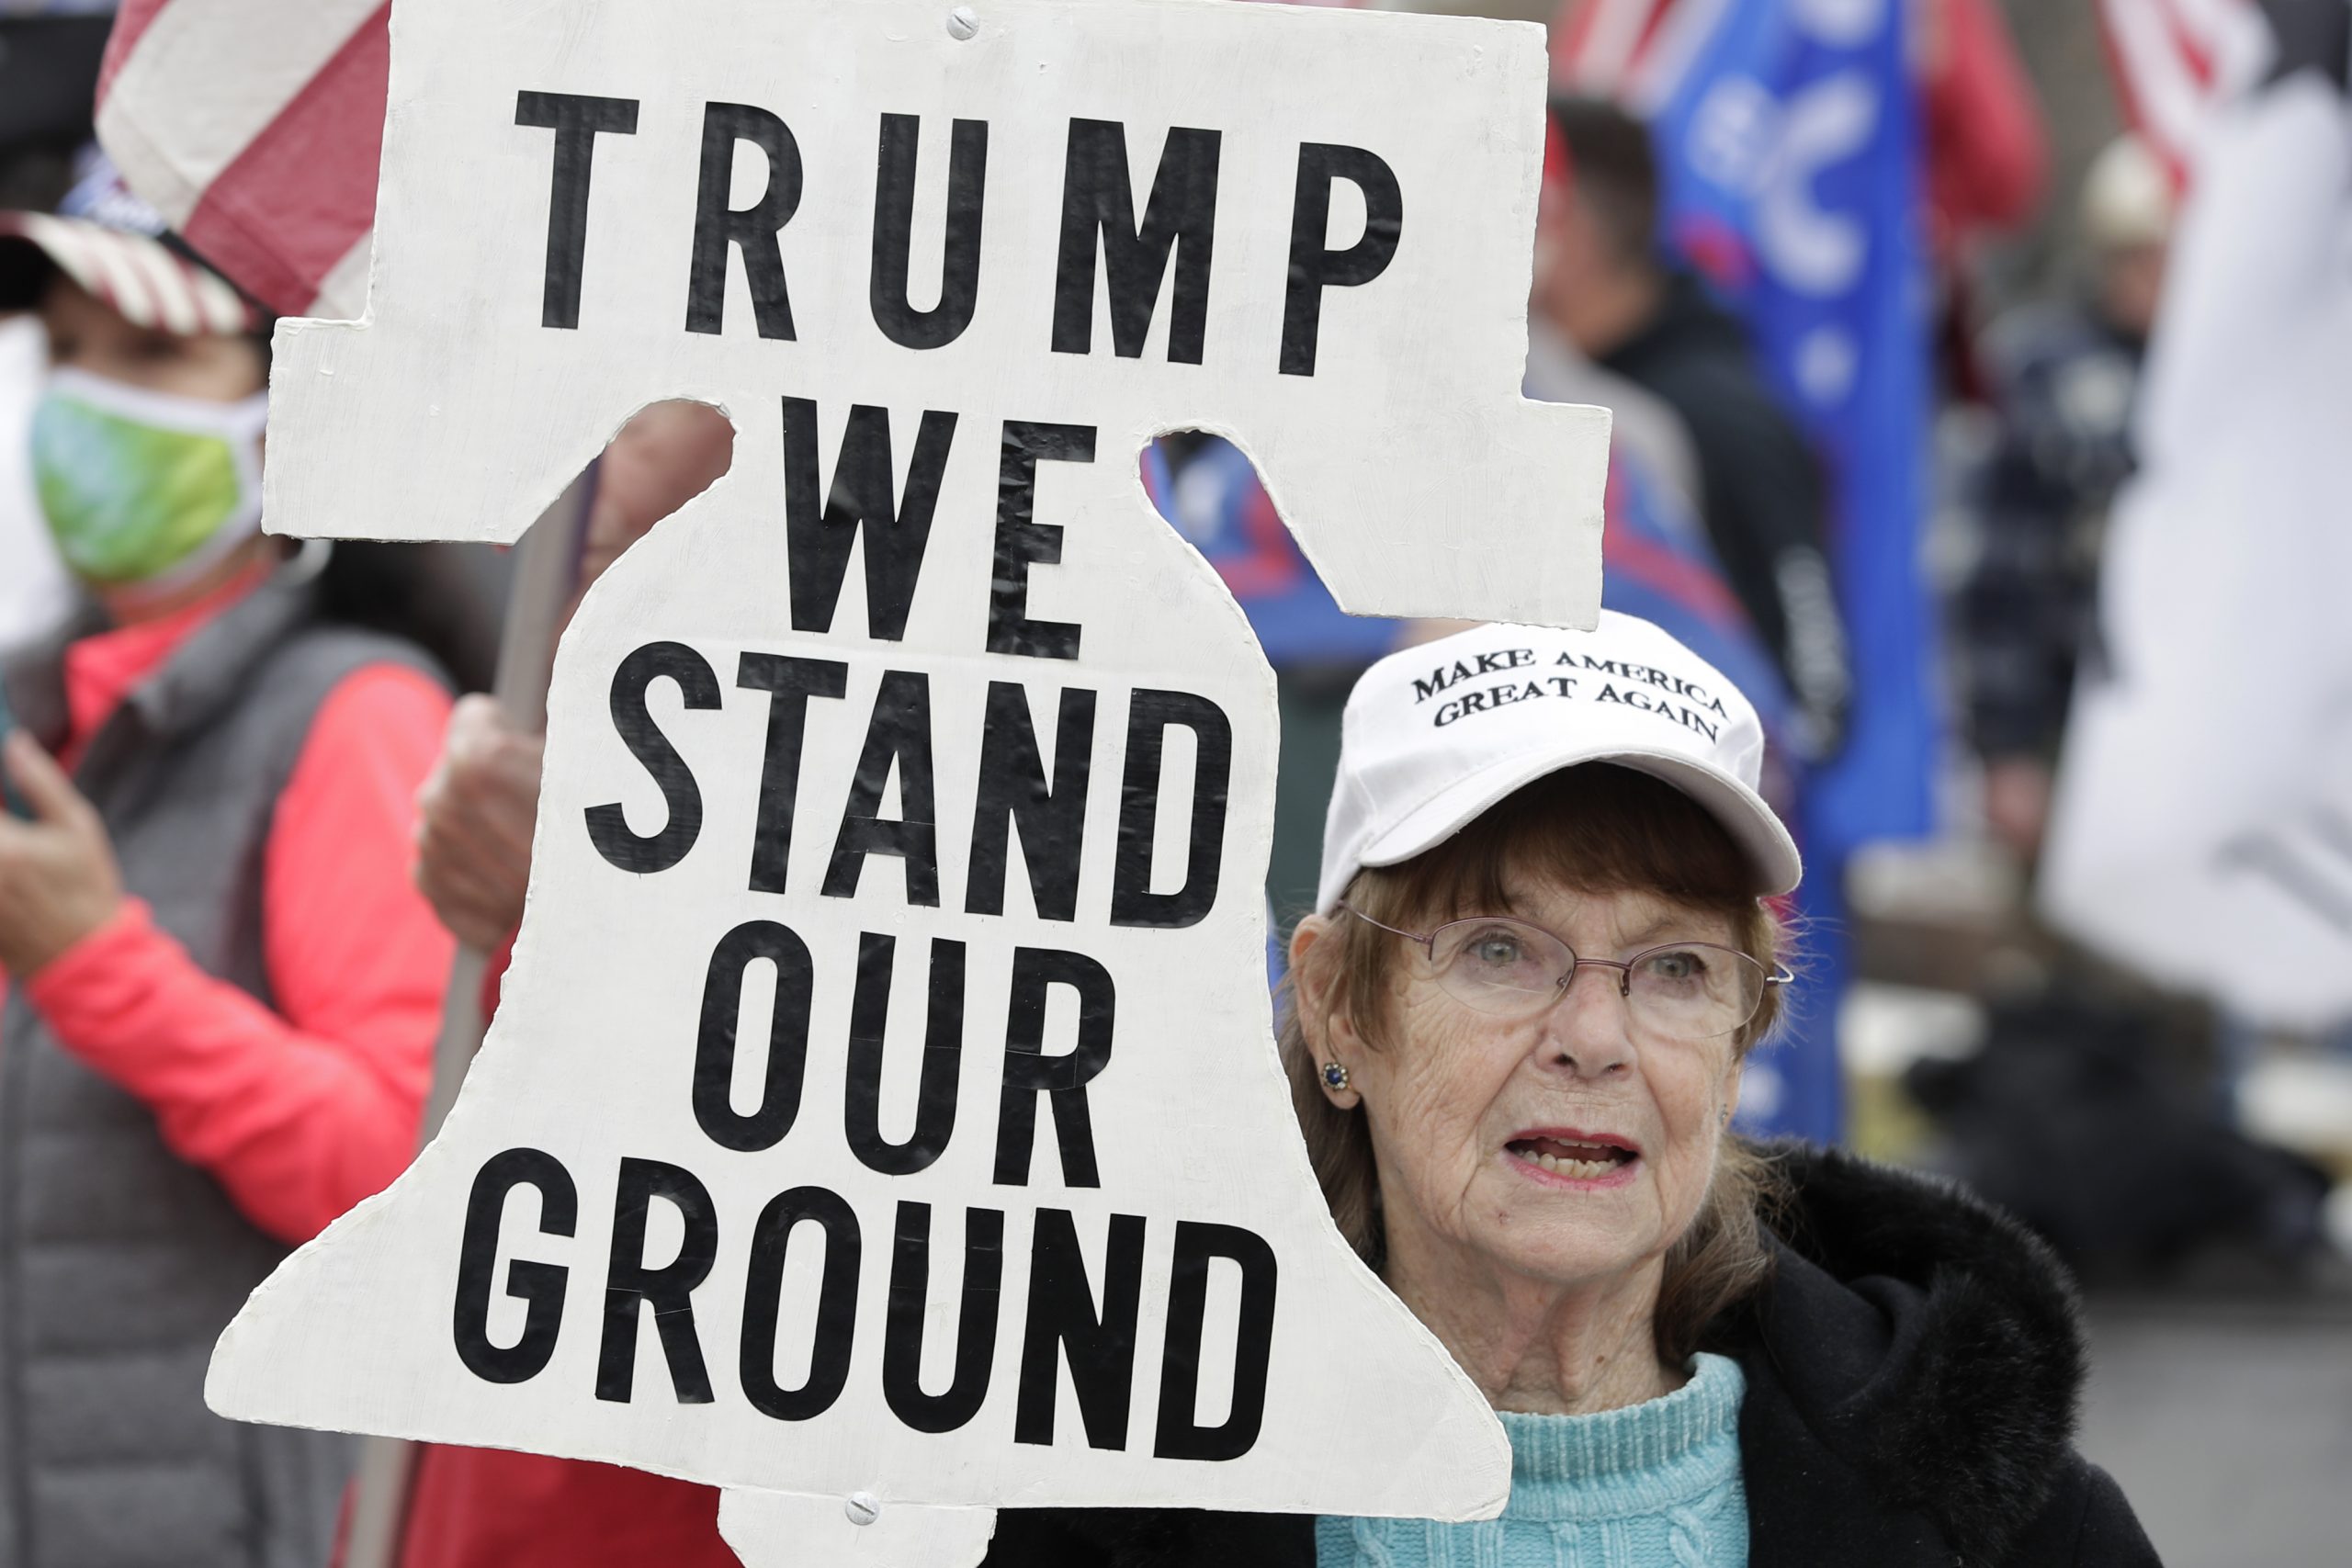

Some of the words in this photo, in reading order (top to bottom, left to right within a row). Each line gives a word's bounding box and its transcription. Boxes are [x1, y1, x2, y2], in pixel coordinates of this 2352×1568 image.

[515, 91, 1403, 378] TRUMP
[782, 396, 1098, 660] WE
[584, 641, 1233, 929] STAND
[1411, 649, 1537, 705] MAKE
[1555, 650, 1732, 724] AMERICA
[1433, 676, 1577, 728] GREAT
[1595, 682, 1720, 745] AGAIN
[693, 920, 1116, 1189] OUR
[454, 1148, 1278, 1462] GROUND
